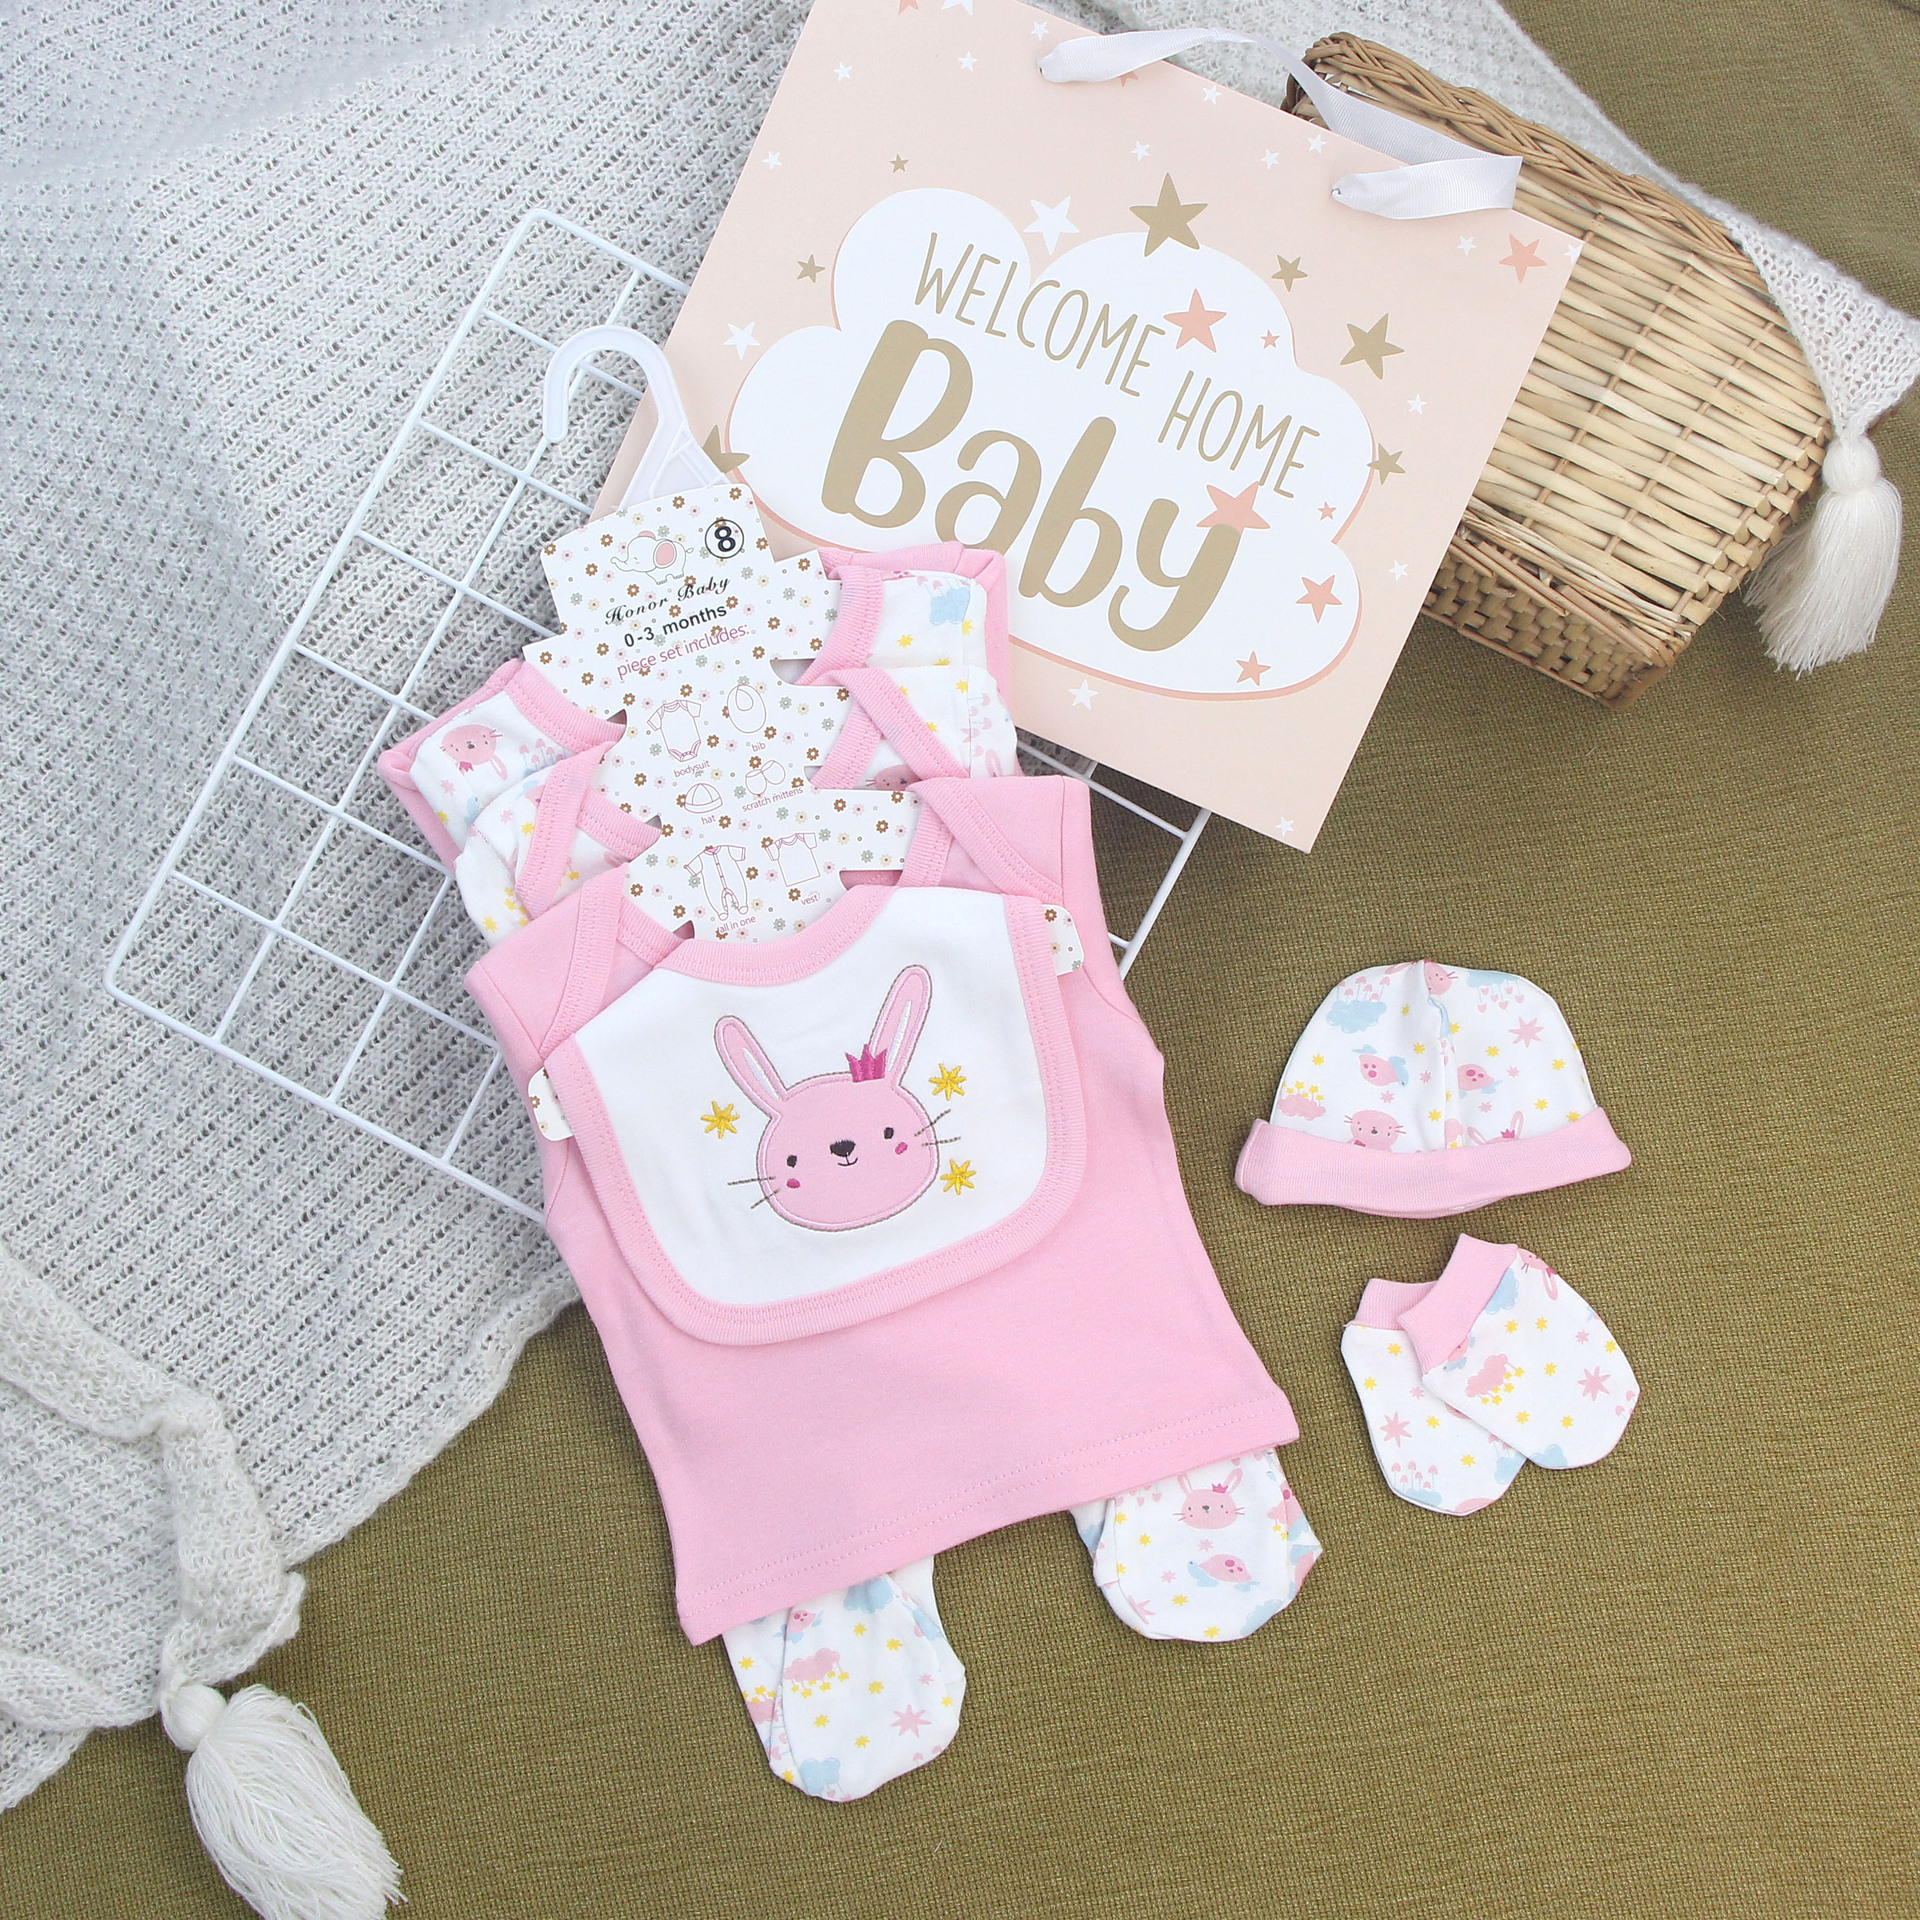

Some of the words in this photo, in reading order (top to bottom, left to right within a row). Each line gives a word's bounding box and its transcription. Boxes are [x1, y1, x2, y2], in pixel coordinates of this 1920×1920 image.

[914, 231, 1166, 397] WELCOME
[1157, 369, 1321, 499] HOME
[821, 319, 1242, 652] Baby
[714, 525, 736, 552] 8
[605, 598, 668, 625] Honor
[677, 576, 731, 601] Baby
[624, 626, 655, 647] 0-3
[662, 606, 727, 635] months
[616, 654, 657, 680] piece
[659, 644, 683, 663] set
[684, 624, 750, 654] includes:
[751, 741, 766, 752] bib
[673, 760, 710, 778] bodysuit
[742, 796, 772, 812] scratch
[772, 787, 804, 803] mittens
[701, 814, 717, 825] hat
[800, 894, 818, 906] vest
[719, 922, 730, 934] all
[730, 920, 739, 930] in
[740, 915, 757, 927] one
